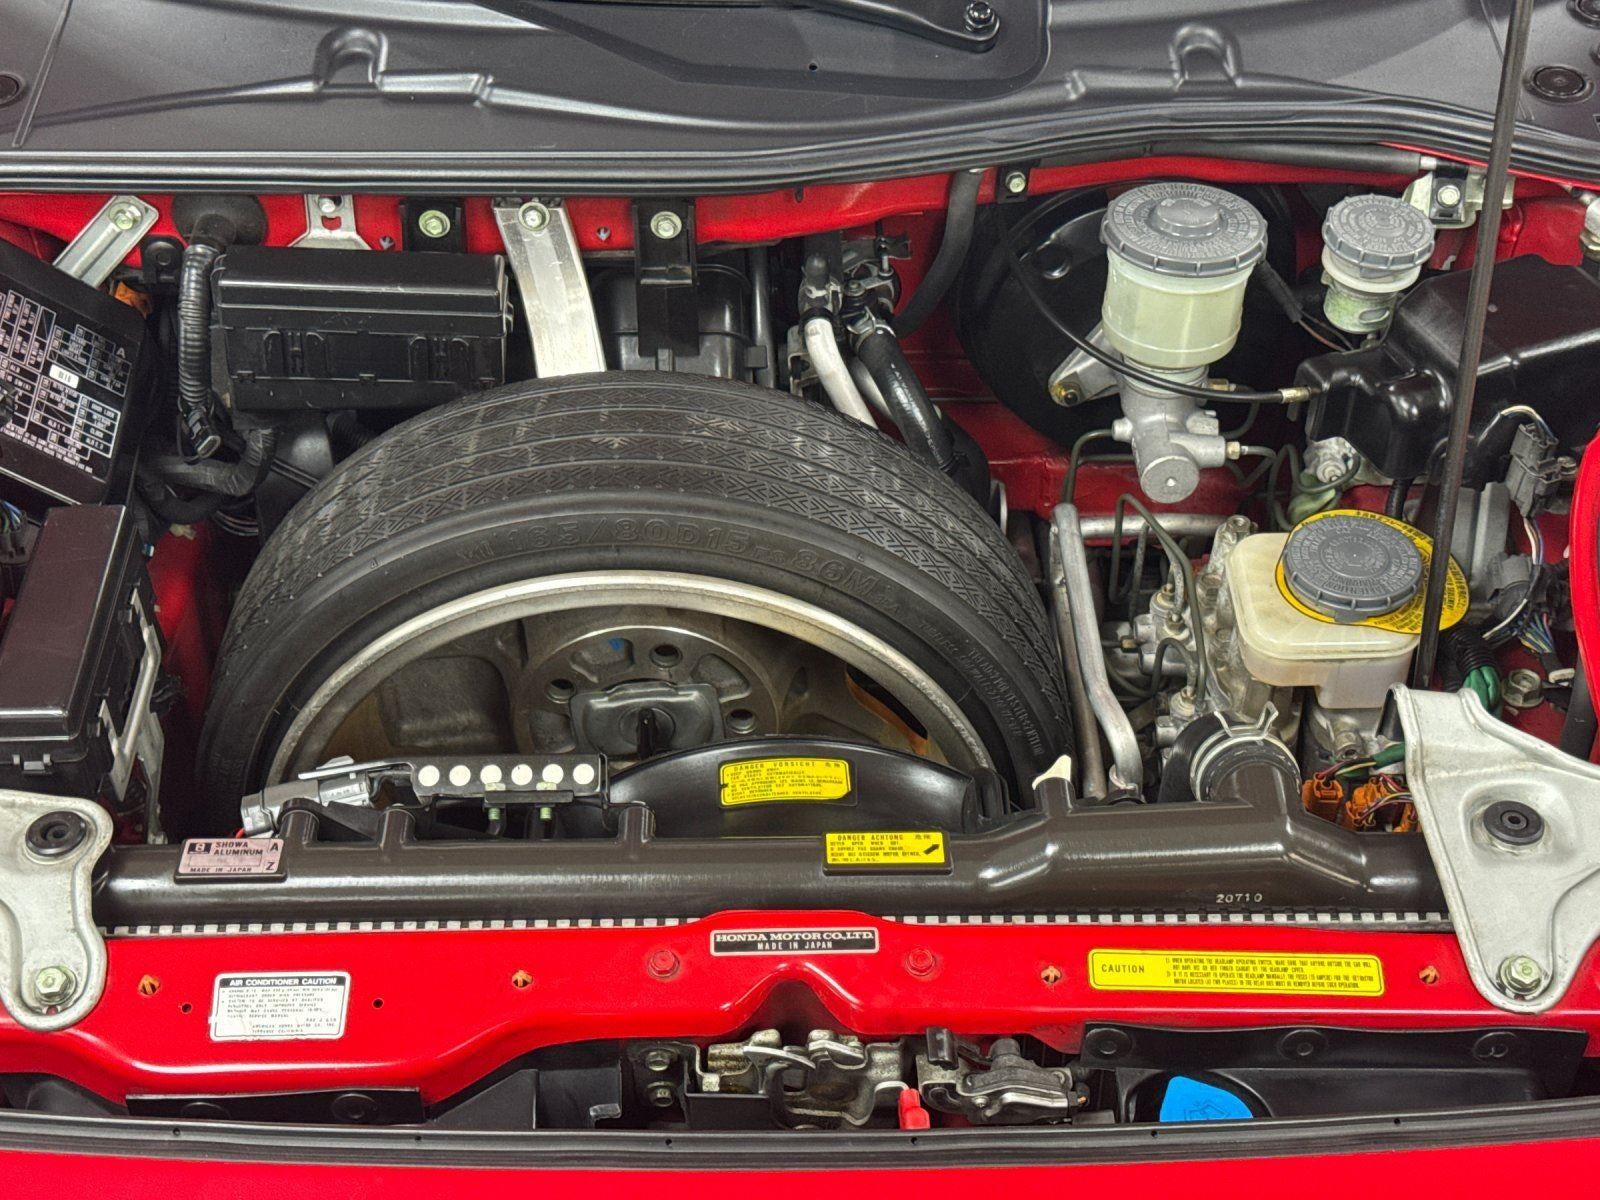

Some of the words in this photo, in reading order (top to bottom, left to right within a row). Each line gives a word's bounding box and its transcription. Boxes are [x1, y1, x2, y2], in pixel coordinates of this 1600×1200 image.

[270, 842, 279, 852] A
[266, 862, 275, 870] Z
[1216, 892, 1262, 904] 20710
[716, 933, 767, 942] HONDA
[770, 932, 822, 941] MOTOR
[757, 942, 783, 950] MADE
[804, 941, 833, 949] JAPAN
[1101, 964, 1146, 974] CAUTION
[246, 978, 300, 986] CONDITIONER
